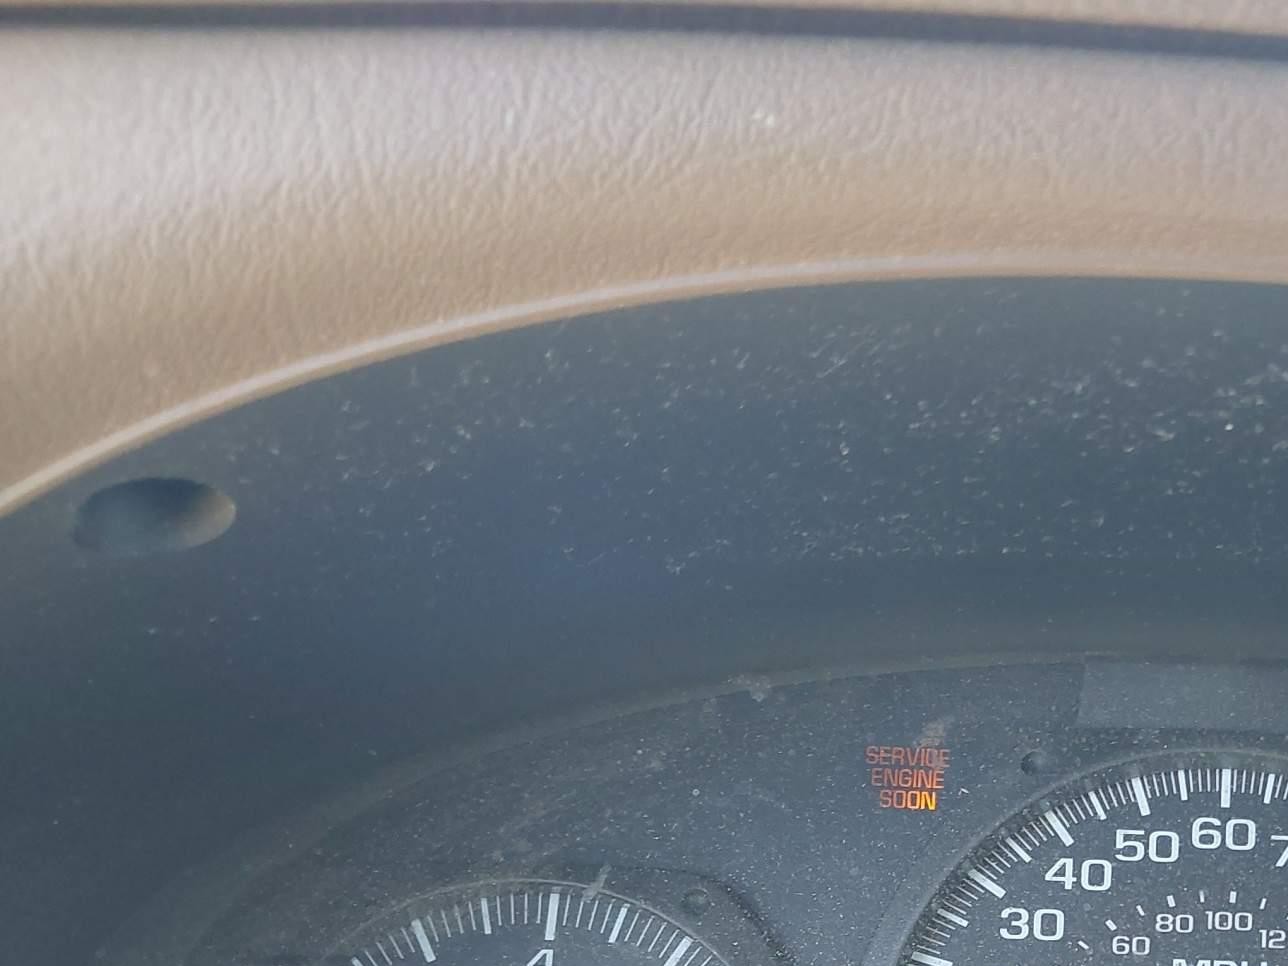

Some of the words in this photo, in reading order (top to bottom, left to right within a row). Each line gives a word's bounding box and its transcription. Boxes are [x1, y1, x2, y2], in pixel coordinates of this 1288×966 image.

[865, 745, 951, 768] SERVICE
[871, 767, 944, 789] ENGINE
[880, 789, 936, 810] SOON
[1190, 818, 1256, 851] 60
[1114, 829, 1180, 863] 50
[1044, 858, 1112, 891] 40
[999, 908, 1064, 940] 30
[1155, 913, 1194, 933] 80
[1205, 911, 1253, 932] 100
[1111, 935, 1151, 956] 60
